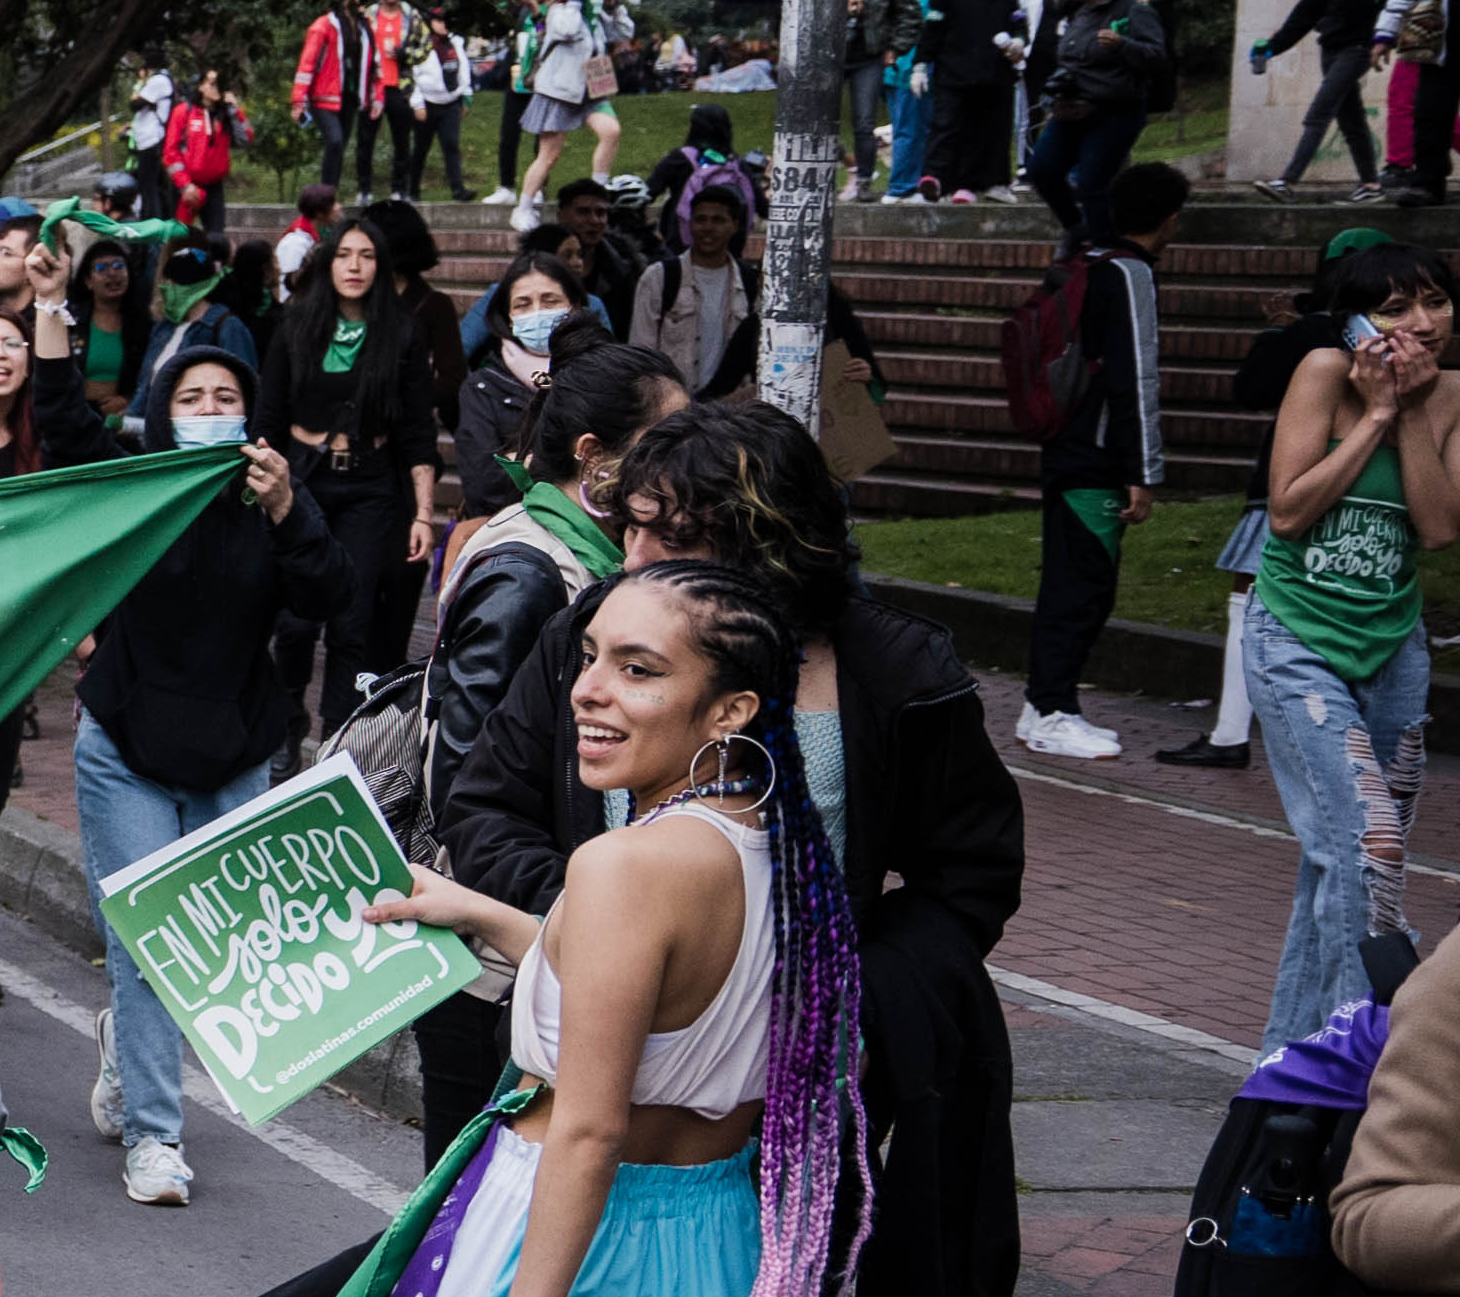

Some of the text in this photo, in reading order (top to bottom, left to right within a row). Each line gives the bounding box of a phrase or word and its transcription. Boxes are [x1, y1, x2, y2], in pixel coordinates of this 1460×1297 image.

[1337, 507, 1361, 537] MI
[136, 824, 382, 1012] EN MI CUERPO
[275, 974, 434, 1085] @doslatinas.comunidad
